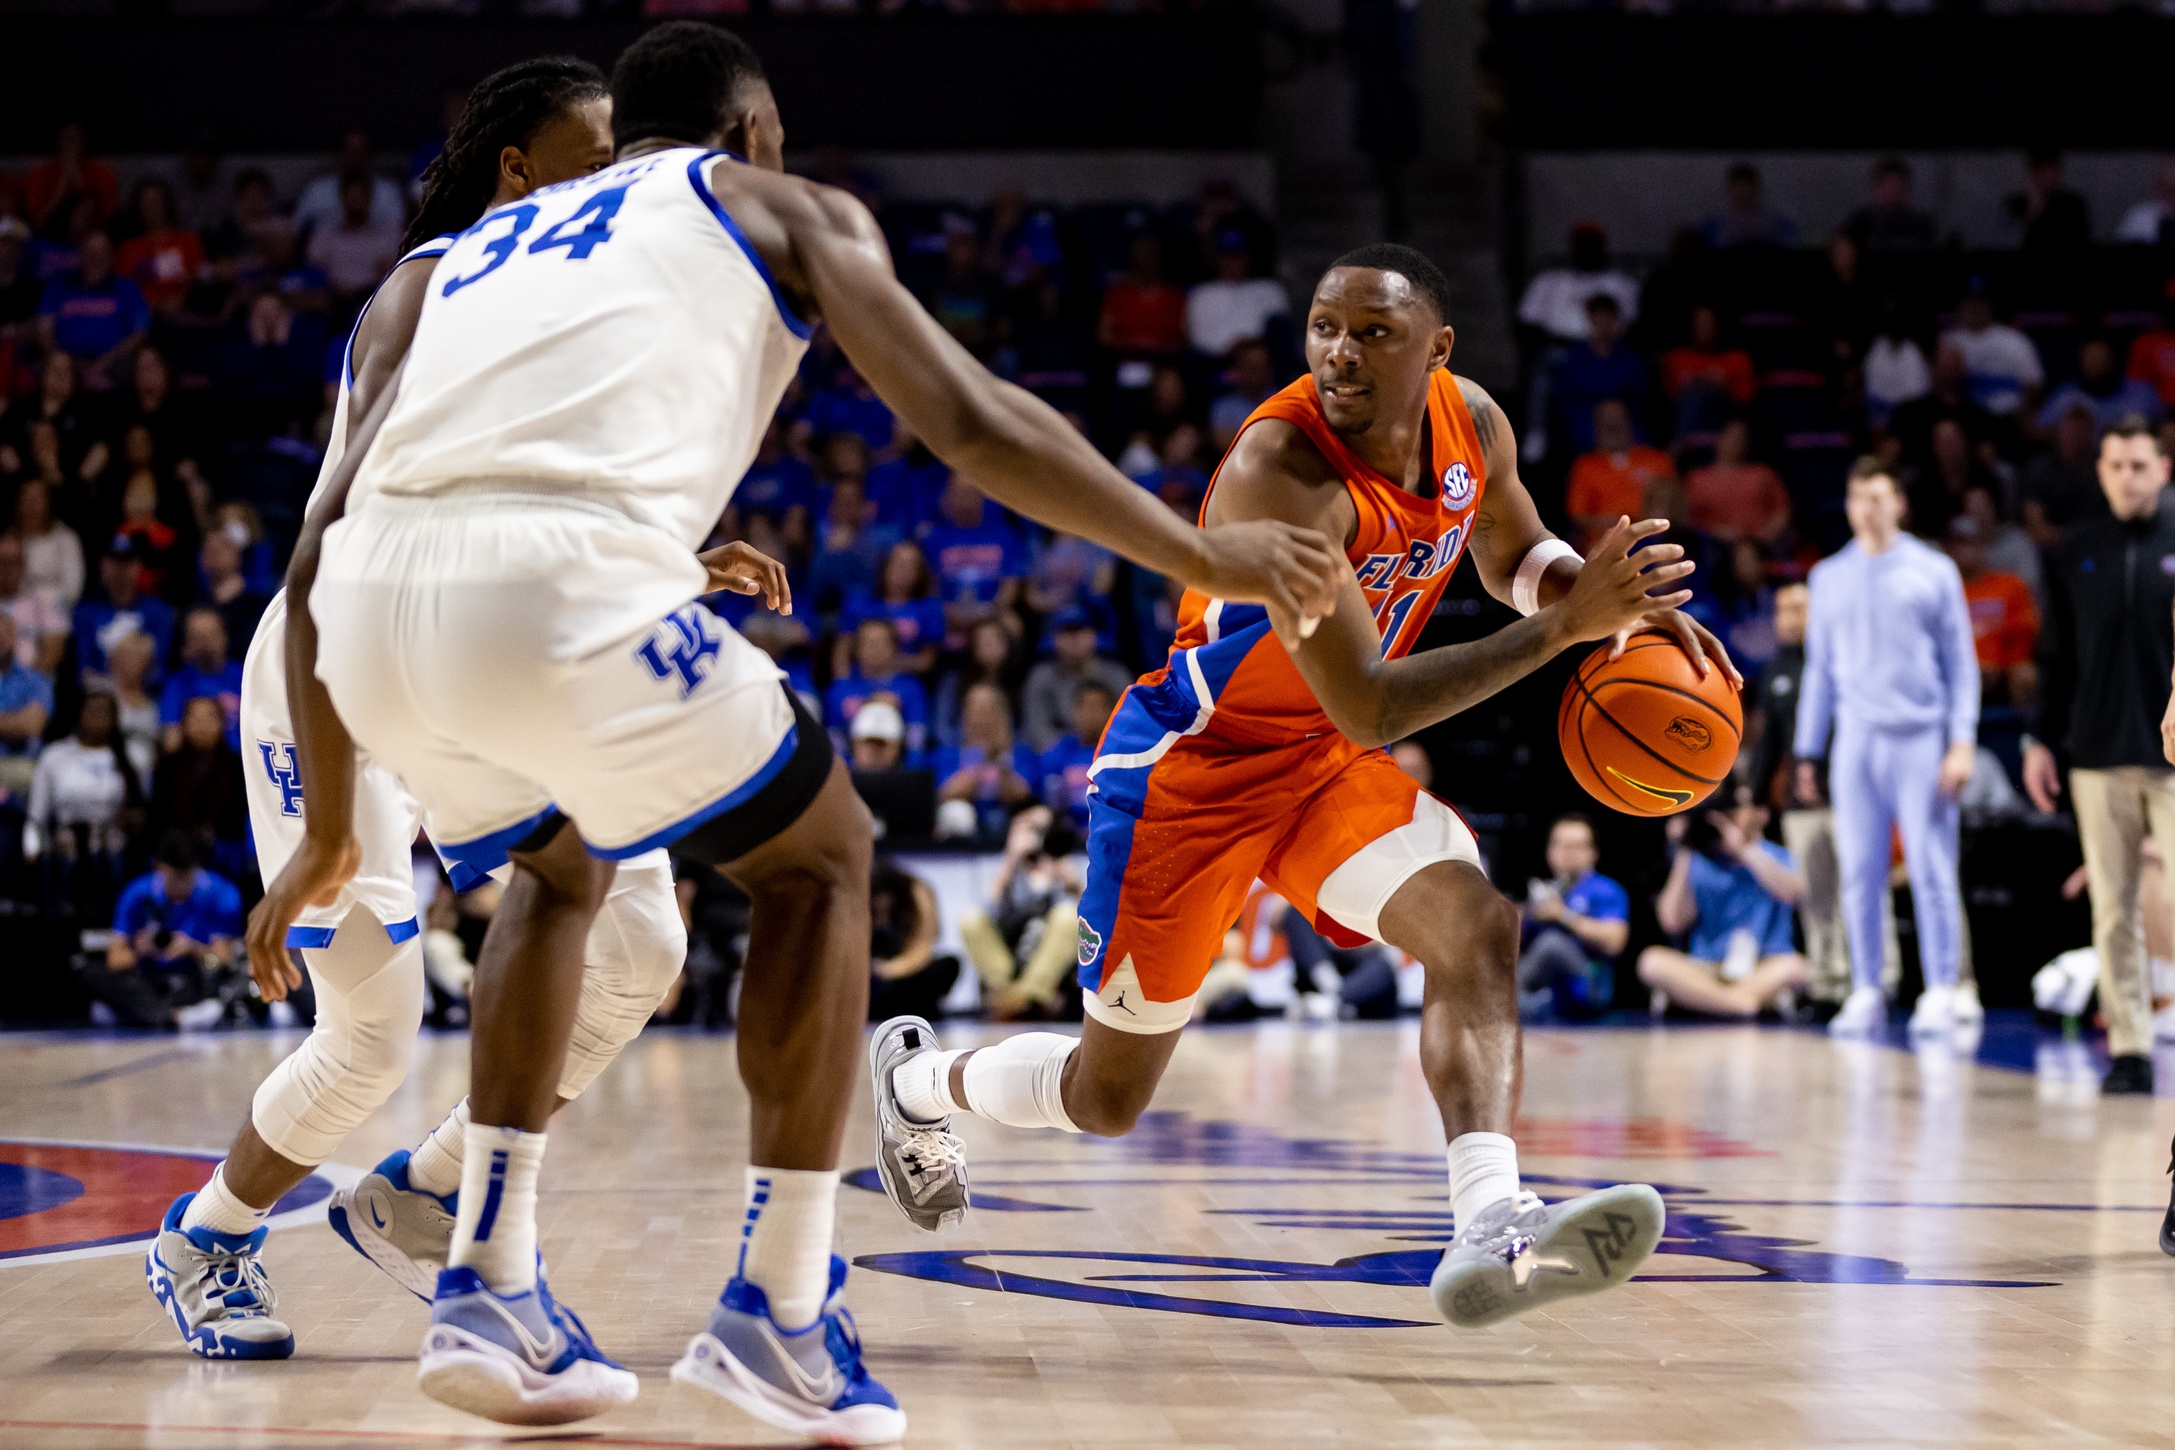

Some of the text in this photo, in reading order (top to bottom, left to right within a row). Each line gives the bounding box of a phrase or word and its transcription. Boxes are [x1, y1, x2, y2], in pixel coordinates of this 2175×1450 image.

[442, 178, 641, 298] 34
[1444, 463, 1469, 498] SEC
[1356, 509, 1475, 591] FLRID
[634, 605, 720, 699] UK
